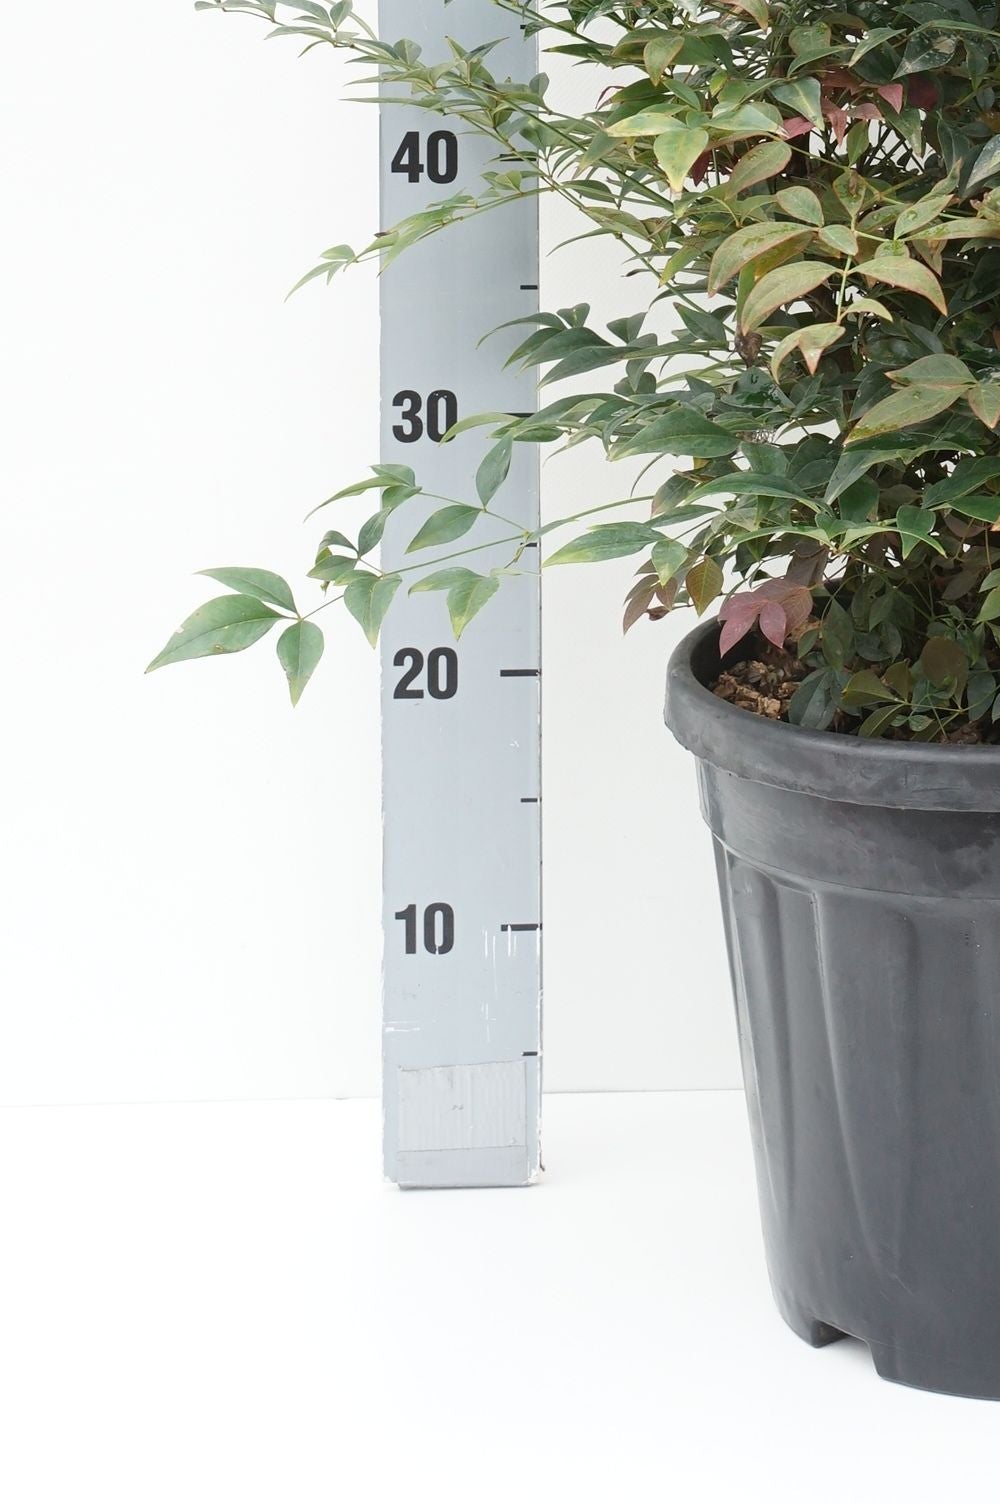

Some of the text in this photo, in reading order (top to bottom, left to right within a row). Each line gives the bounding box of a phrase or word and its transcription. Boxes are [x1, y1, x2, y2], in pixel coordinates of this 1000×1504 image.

[391, 130, 459, 184] 40
[392, 389, 458, 443] 30
[393, 647, 458, 700] 20
[395, 903, 454, 955] 10
